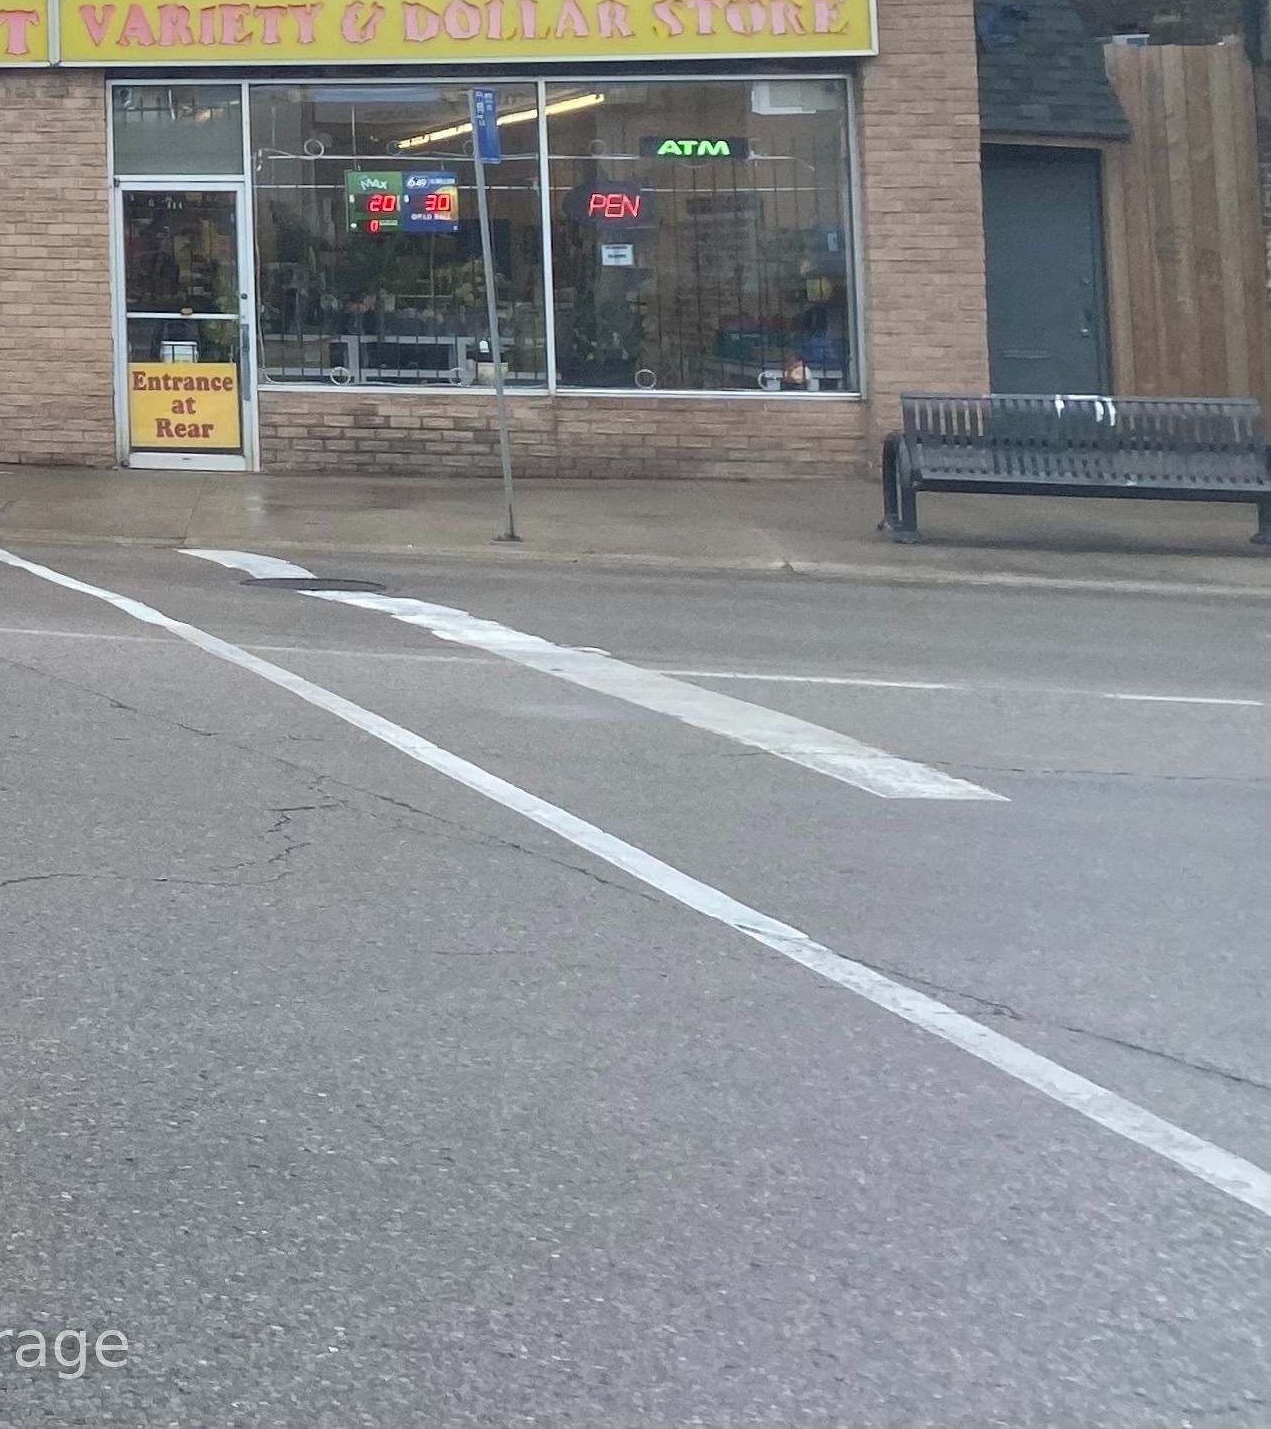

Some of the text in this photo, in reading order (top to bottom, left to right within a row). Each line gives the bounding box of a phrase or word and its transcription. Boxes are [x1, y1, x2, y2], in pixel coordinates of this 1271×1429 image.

[79, 1, 323, 46] VARIETY
[657, 140, 731, 156] ATM
[361, 178, 388, 190] MAX
[369, 194, 396, 212] 20
[425, 194, 451, 211] 30
[370, 219, 379, 232] 0
[132, 371, 234, 391] Entrance
[171, 396, 197, 415] at
[155, 418, 215, 438] Rear
